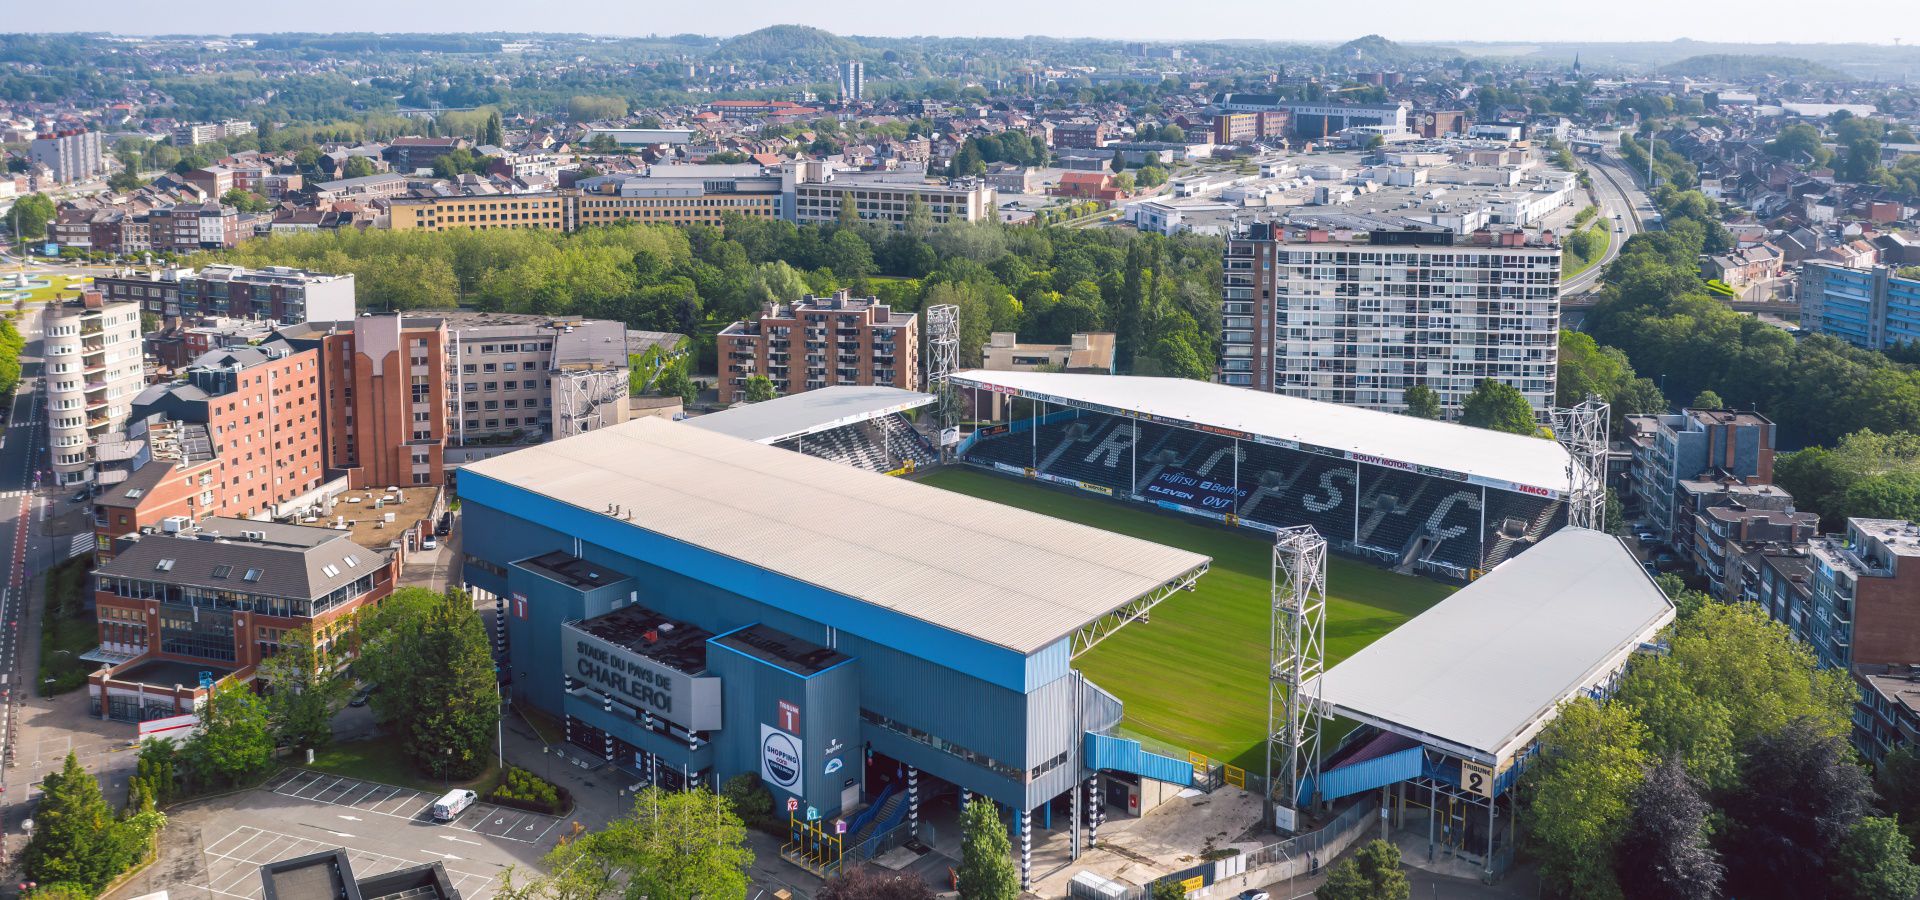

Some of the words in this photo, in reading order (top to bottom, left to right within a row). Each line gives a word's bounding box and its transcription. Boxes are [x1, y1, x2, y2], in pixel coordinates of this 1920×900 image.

[1352, 453, 1382, 464] BOUVY
[1381, 459, 1408, 470] MOTOR
[1518, 484, 1548, 496] JEMCO
[576, 641, 609, 664] STADE
[610, 655, 625, 671] DU
[628, 662, 653, 683] PAYS
[655, 674, 671, 691] DE
[577, 658, 672, 713] CHARLEROI
[786, 711, 792, 731] 1
[767, 745, 797, 764] SHOPPING
[1463, 762, 1492, 777] TRIBUNE
[1469, 772, 1483, 794] 2
[787, 801, 798, 811] K2
[807, 808, 818, 820] K1
